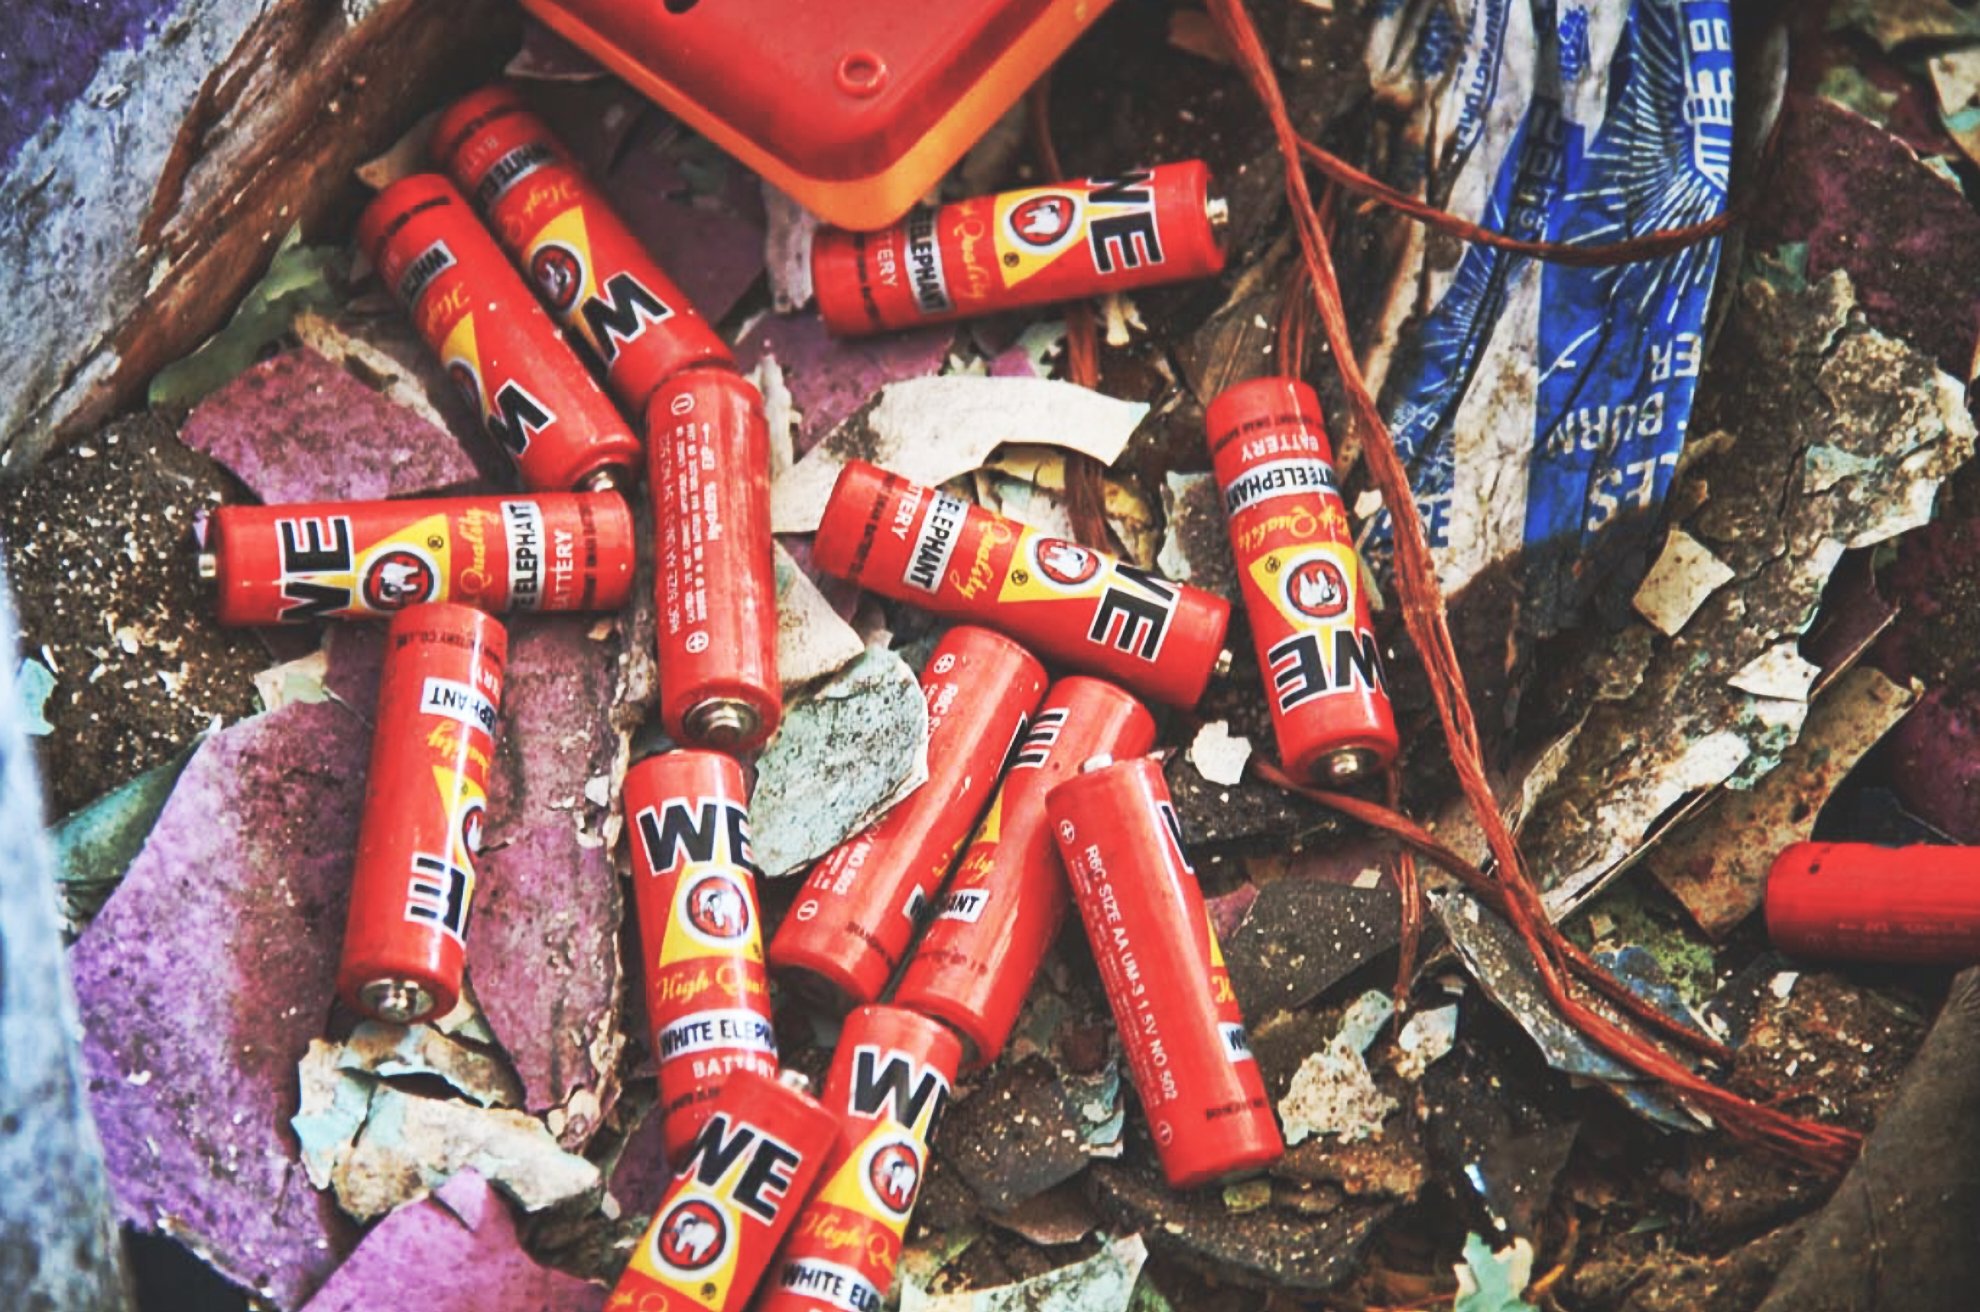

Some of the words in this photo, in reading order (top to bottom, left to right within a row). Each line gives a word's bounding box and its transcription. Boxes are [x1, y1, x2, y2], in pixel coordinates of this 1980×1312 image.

[1240, 432, 1320, 462] BATTERY
[1237, 504, 1318, 552] Quality
[459, 507, 500, 596] Quality
[950, 520, 1012, 601] Quality
[656, 967, 711, 1007] High
[1095, 882, 1124, 926] SIZE
[1110, 924, 1132, 952] AA
[1147, 1038, 1170, 1068] NO
[660, 1019, 715, 1057] WHITE
[804, 1209, 862, 1249] High
[783, 1263, 846, 1298] WHITE
